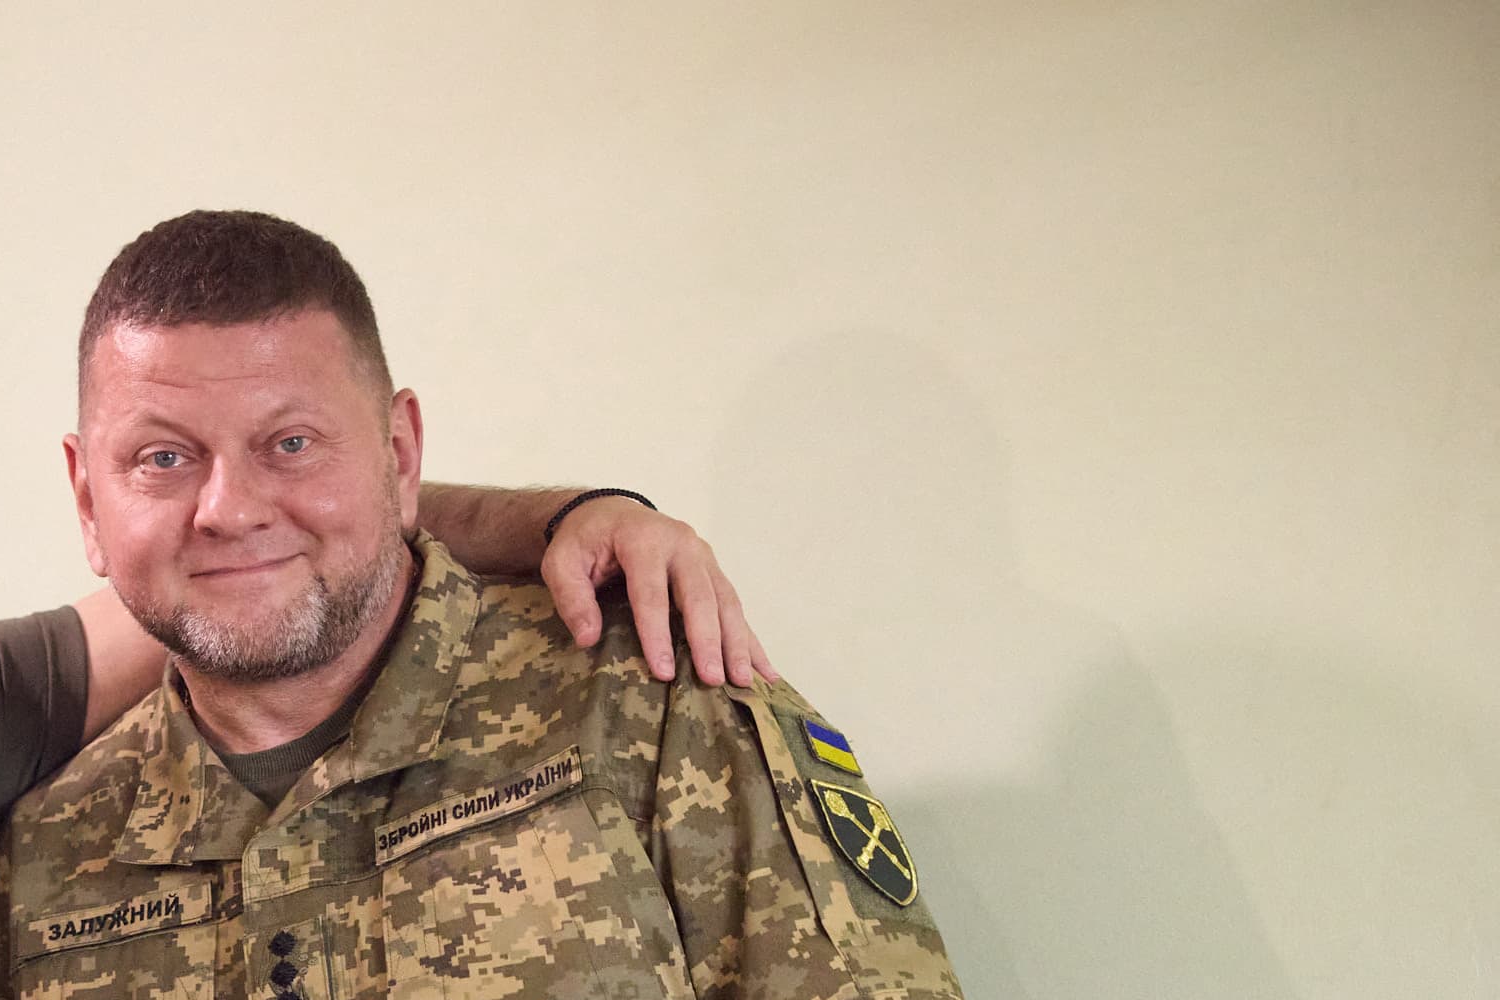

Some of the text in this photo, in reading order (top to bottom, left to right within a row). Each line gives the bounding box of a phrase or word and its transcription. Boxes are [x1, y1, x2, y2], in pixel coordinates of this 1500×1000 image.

[378, 758, 573, 850] ЗБРОЙНІ СИЛИ УКРАЇНИ
[48, 893, 180, 941] ЗАЛУЖНИЙ
